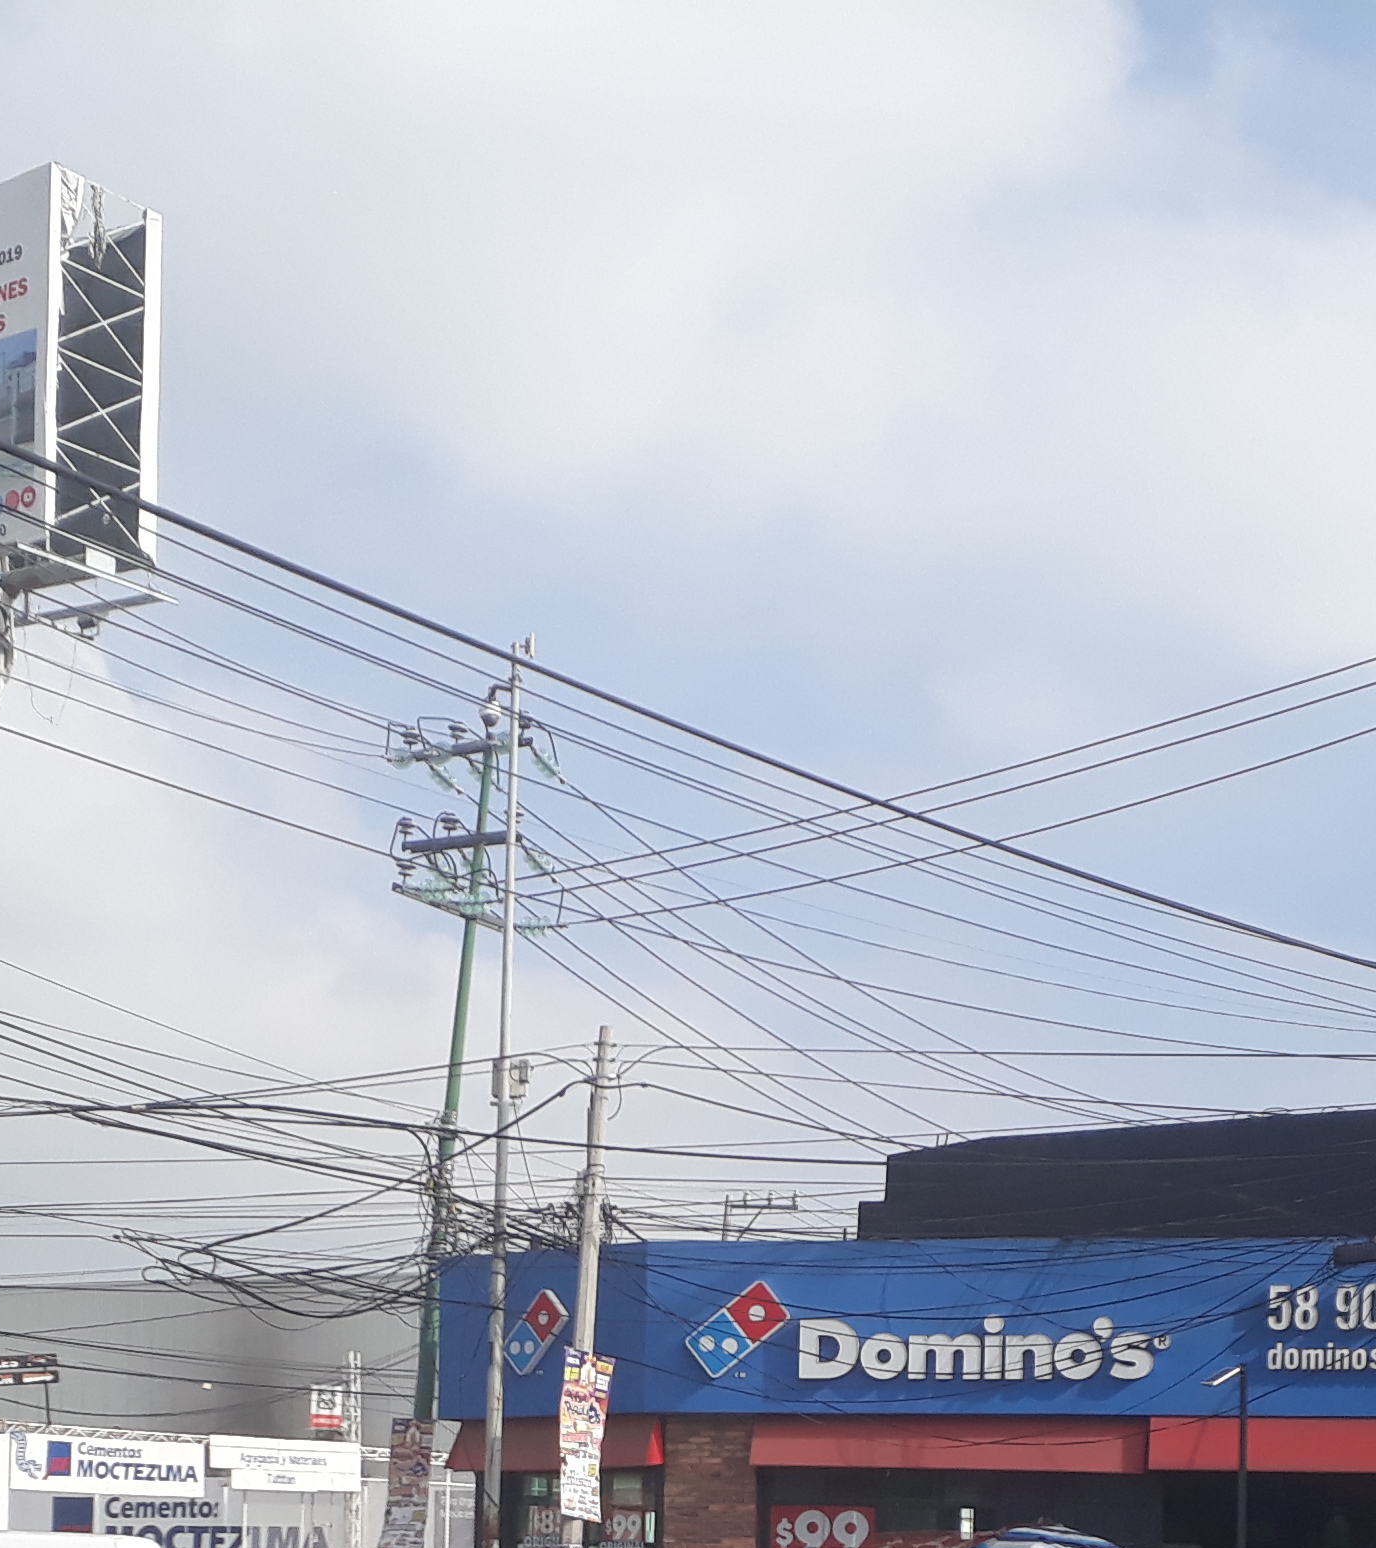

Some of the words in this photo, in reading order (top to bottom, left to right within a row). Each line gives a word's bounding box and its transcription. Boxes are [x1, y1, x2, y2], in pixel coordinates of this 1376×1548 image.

[1267, 1284, 1319, 1330] 58
[76, 1441, 143, 1459] Cementos
[76, 1459, 199, 1484] MOCTEZUMA
